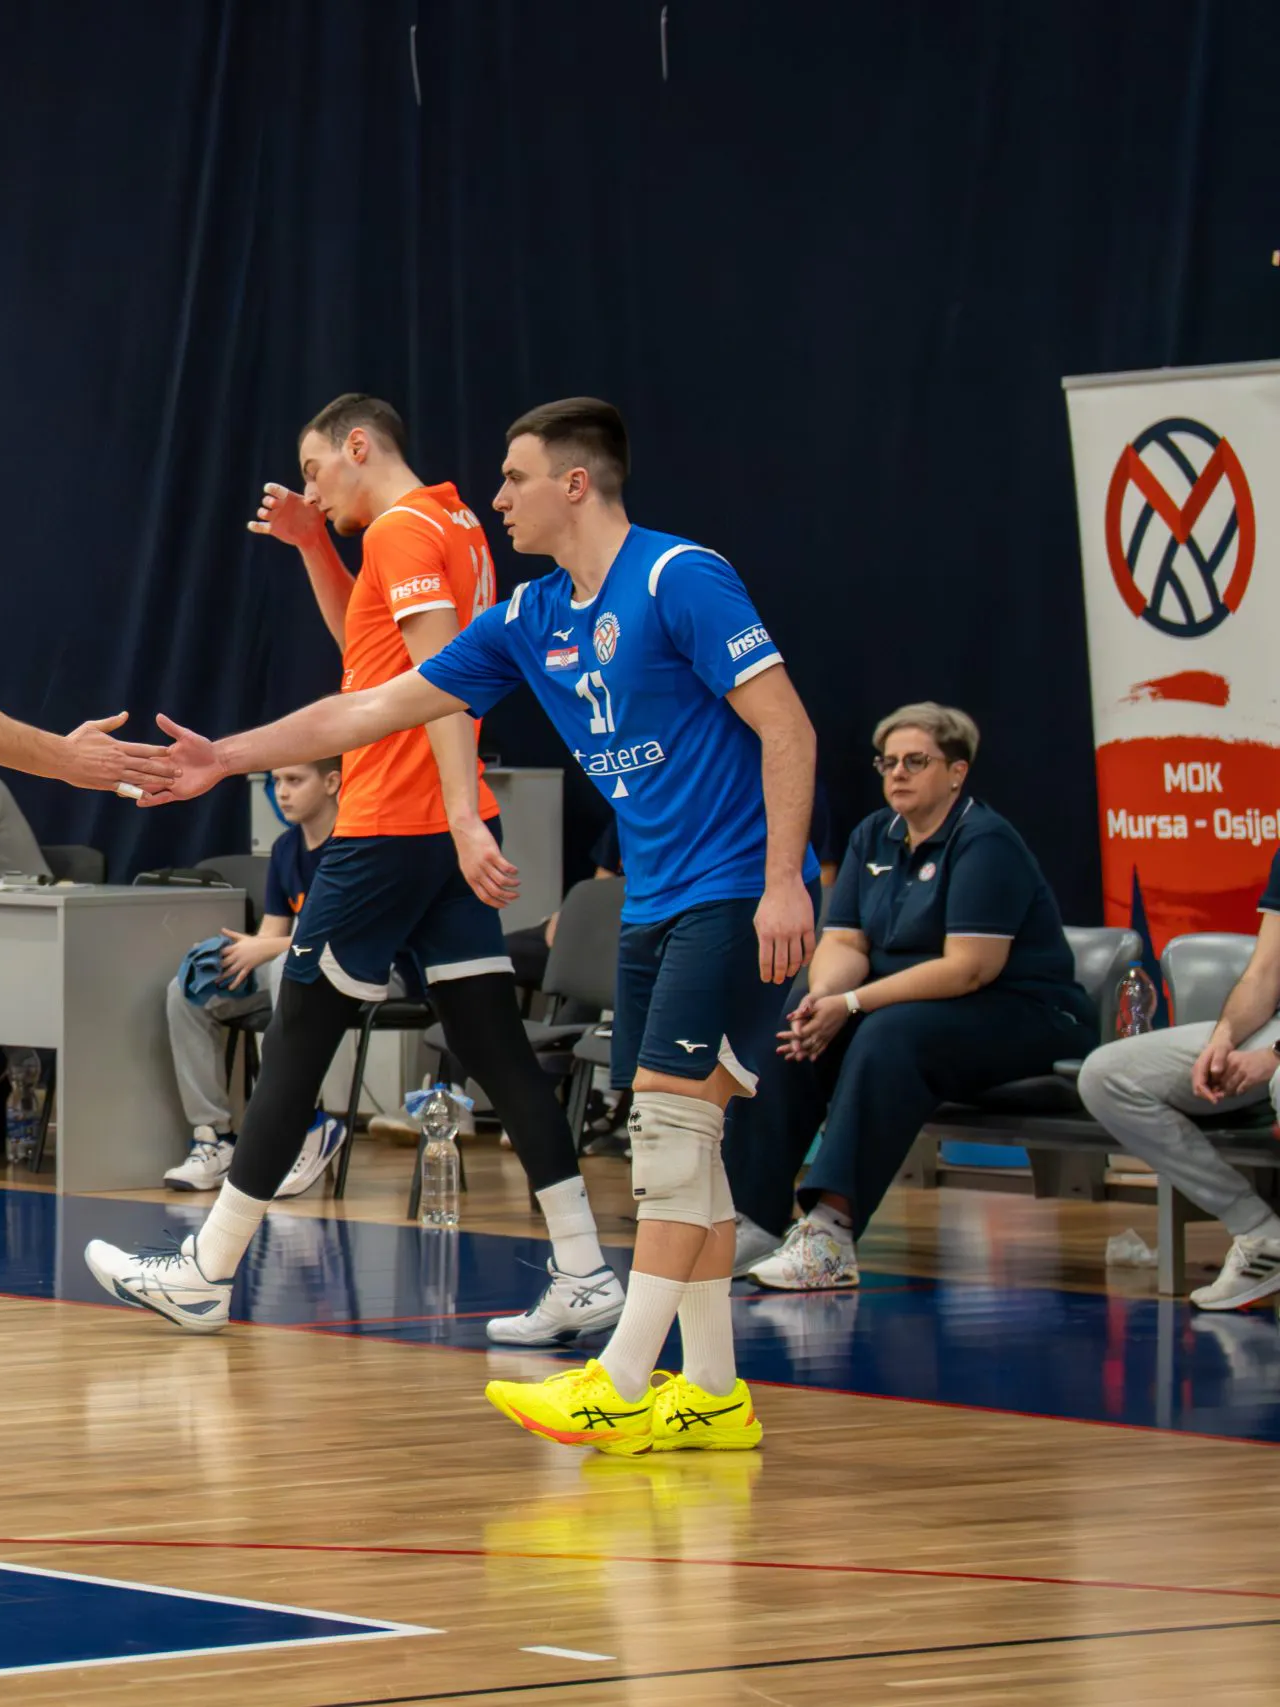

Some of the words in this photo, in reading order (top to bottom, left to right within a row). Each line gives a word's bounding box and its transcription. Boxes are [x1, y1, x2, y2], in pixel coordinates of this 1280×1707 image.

[390, 578, 440, 604] nstos
[727, 627, 770, 659] Insto
[1164, 761, 1223, 793] MOK
[1106, 808, 1189, 839] Mursa
